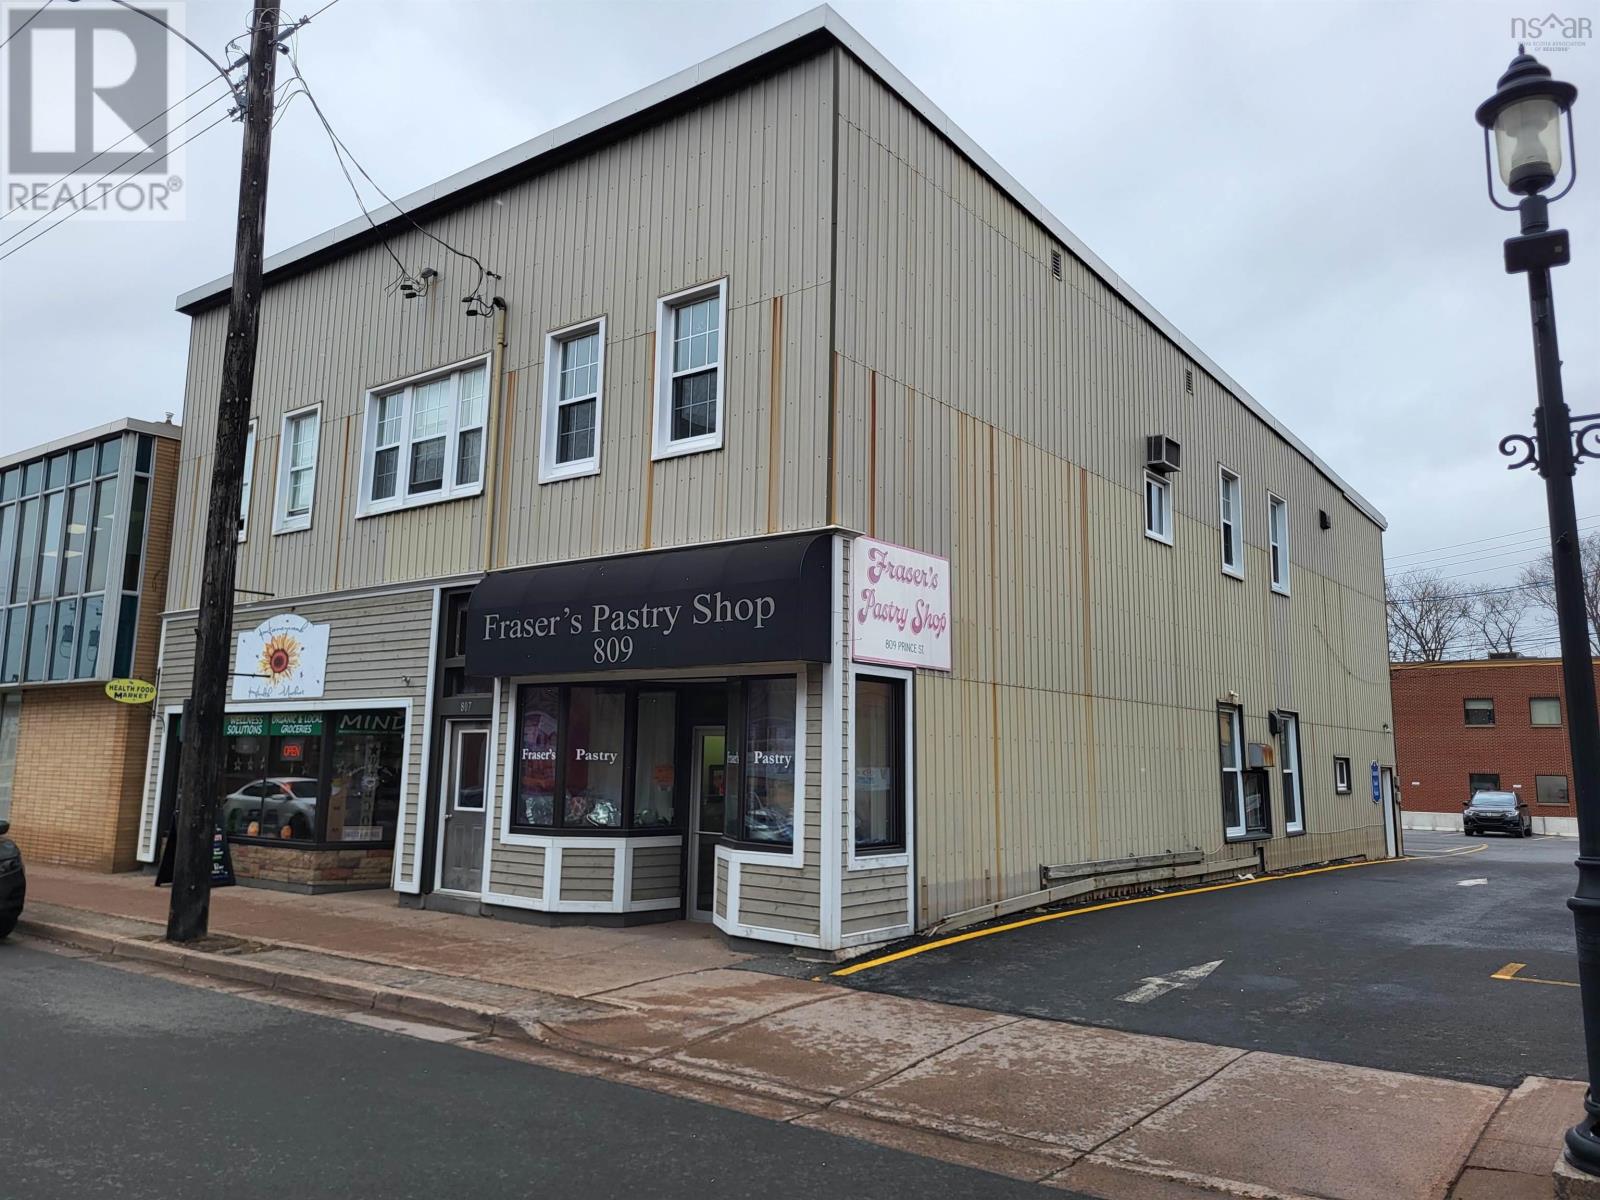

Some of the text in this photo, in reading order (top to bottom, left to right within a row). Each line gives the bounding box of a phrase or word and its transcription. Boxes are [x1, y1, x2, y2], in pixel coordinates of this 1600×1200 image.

[867, 547, 939, 590] Fraser's
[482, 591, 776, 642] Fraser's Pastry Shop
[858, 588, 947, 639] Pastry Shop
[593, 635, 634, 664] 809
[885, 640, 897, 651] 809
[897, 641, 917, 653] PRINCE
[109, 684, 135, 692] HEALTH
[460, 701, 473, 713] 807
[230, 714, 263, 725] WELLNESS
[226, 725, 262, 735] SOLUTIONS
[280, 724, 312, 734] GROCERIES
[522, 748, 618, 765] Fraser's Pastry
[753, 750, 793, 768] Pastry
